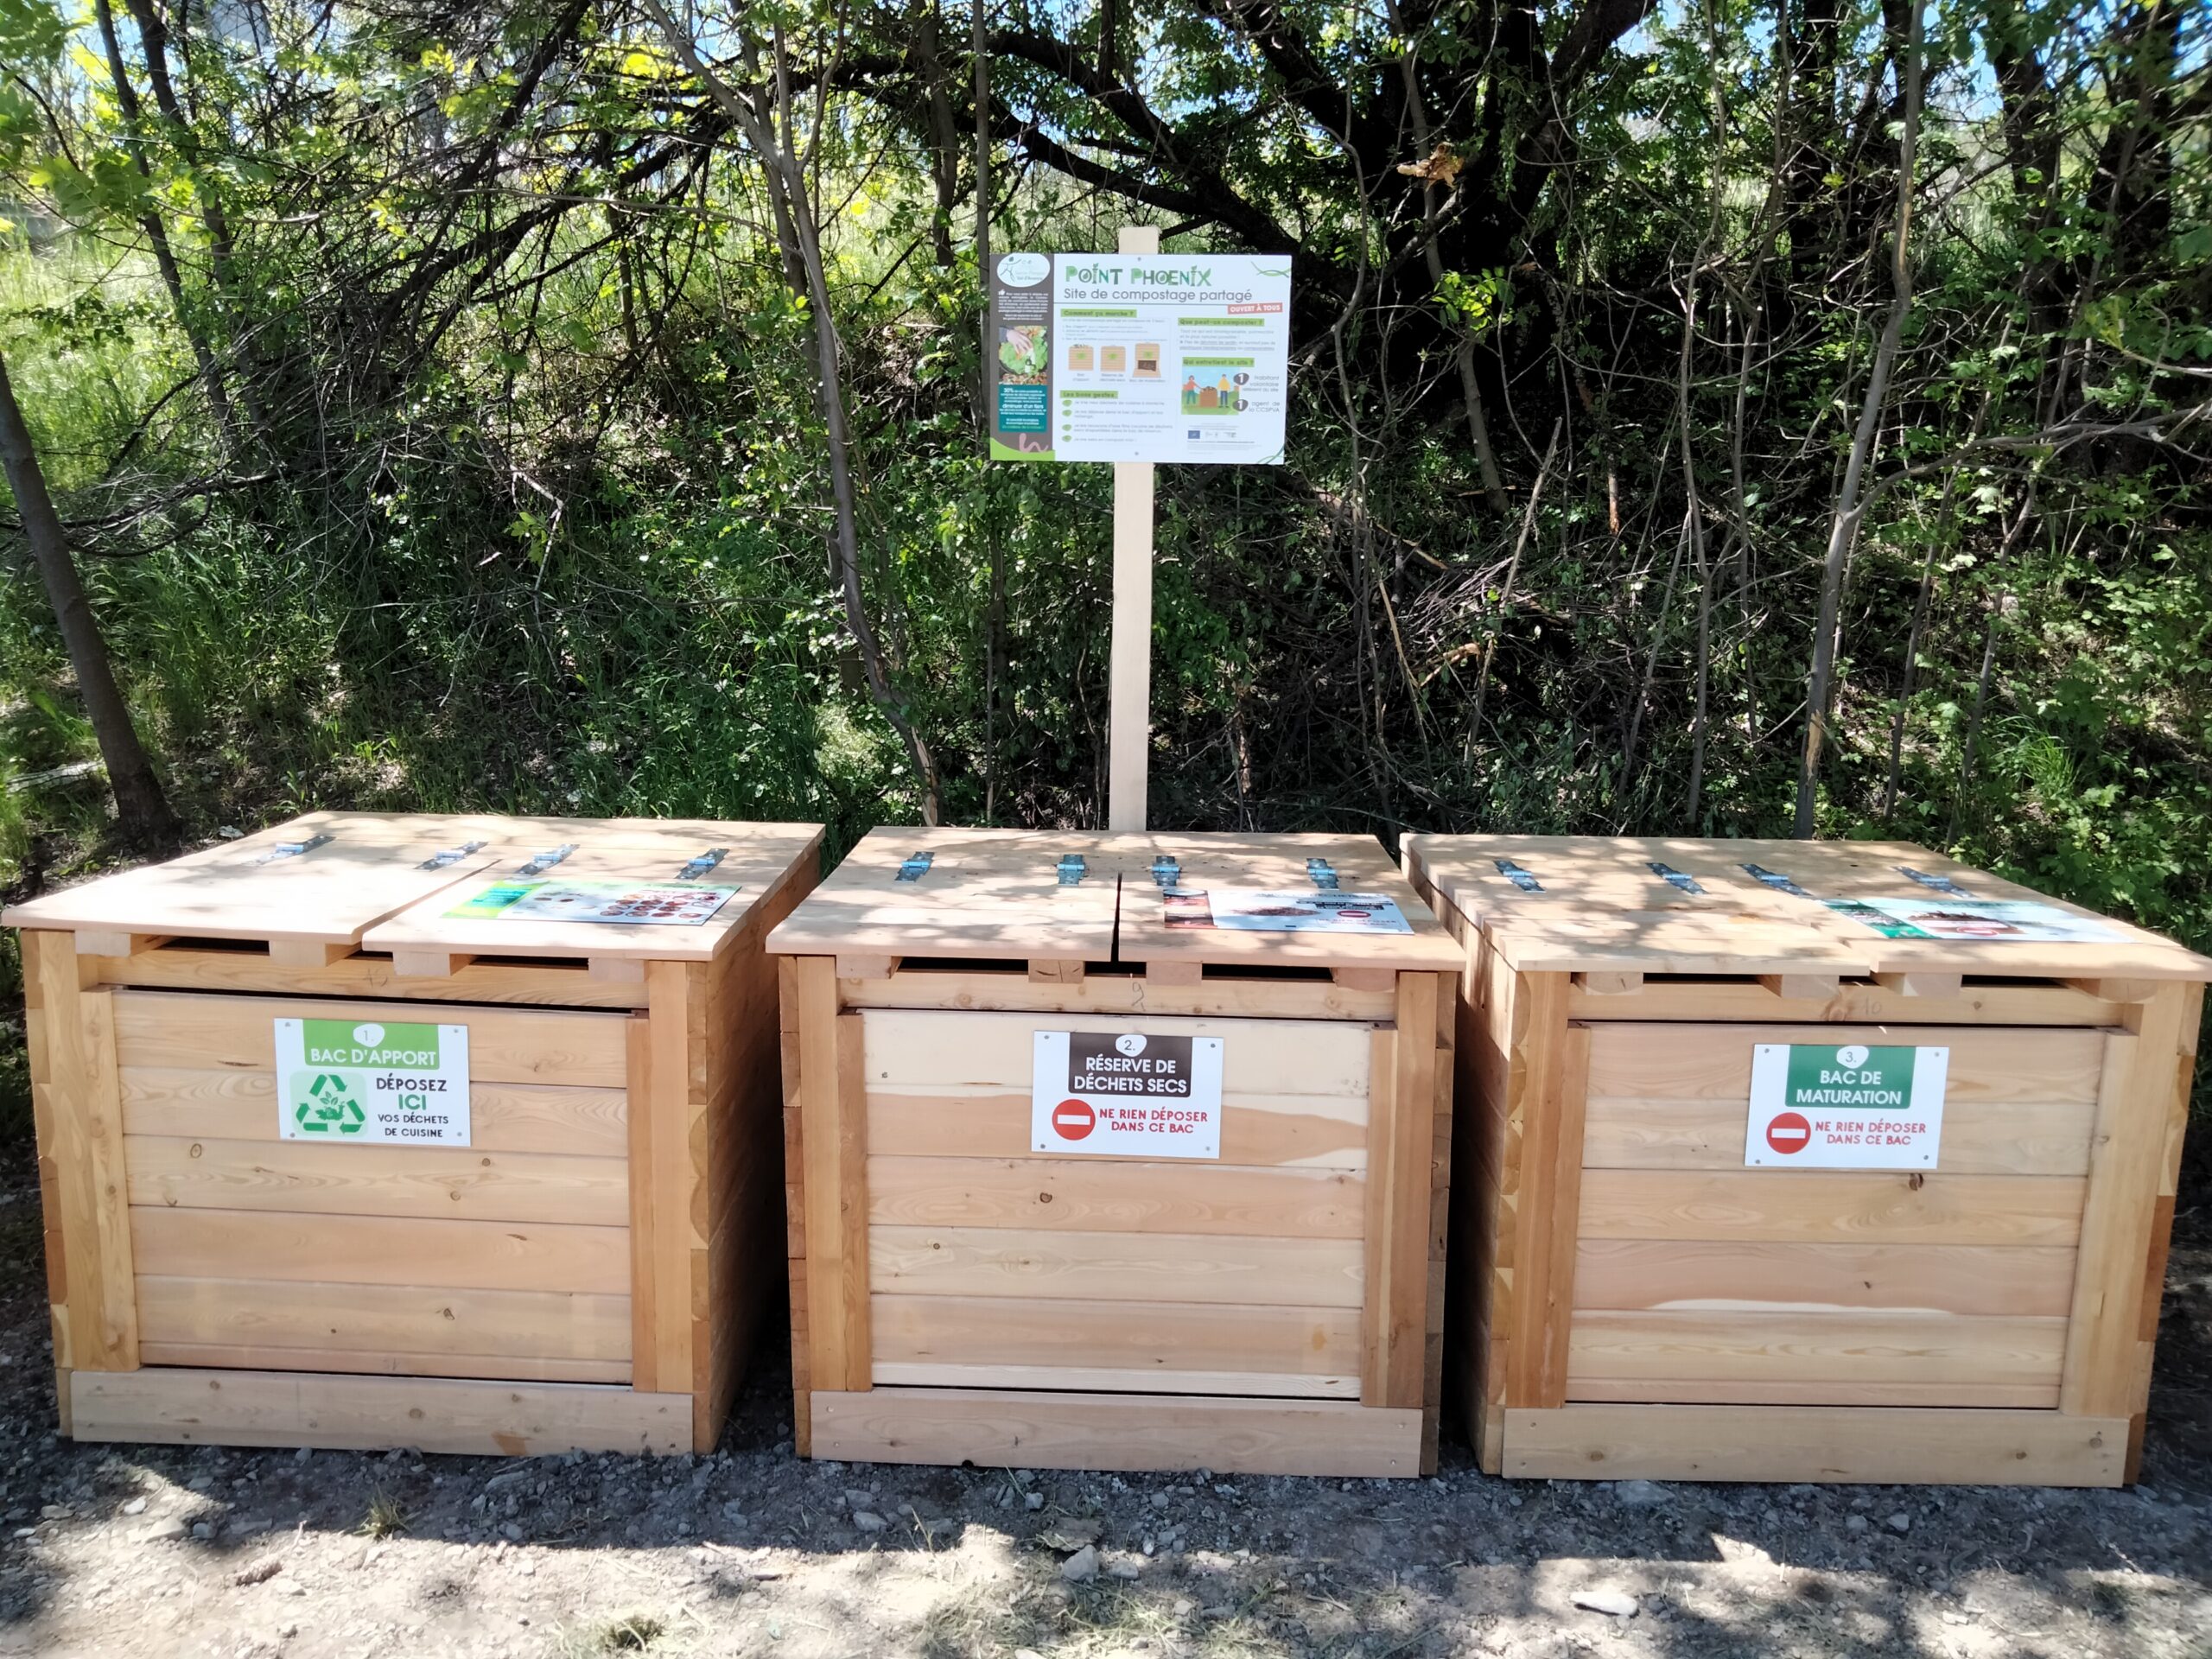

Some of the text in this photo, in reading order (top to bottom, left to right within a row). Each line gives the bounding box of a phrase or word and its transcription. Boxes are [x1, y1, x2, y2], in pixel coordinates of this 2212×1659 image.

[1064, 288, 1253, 303] Site de compostage partagé
[1256, 302, 1262, 312] À
[1238, 373, 1244, 384] 1
[1237, 400, 1243, 410] 1
[309, 1048, 437, 1066] BAC D'APPORT
[1085, 1053, 1176, 1074] RÉSERVE DE
[376, 1072, 448, 1092] DÉPOSEZ
[1073, 1072, 1187, 1094] DÉCHETS SECS
[1819, 1069, 1882, 1085] BAC DE
[397, 1093, 427, 1111] ICI
[1796, 1089, 1903, 1105] MATURATION
[378, 1112, 449, 1124] VOS DÉCHETS
[1099, 1106, 1208, 1122] NE RIEN DÉPOSER
[385, 1128, 443, 1138] DE CUISINE
[1110, 1121, 1194, 1134] DANS CE BAC
[1815, 1118, 1927, 1134] NE RIEN DÉPOSER
[1826, 1134, 1912, 1146] DANS CE BAC
